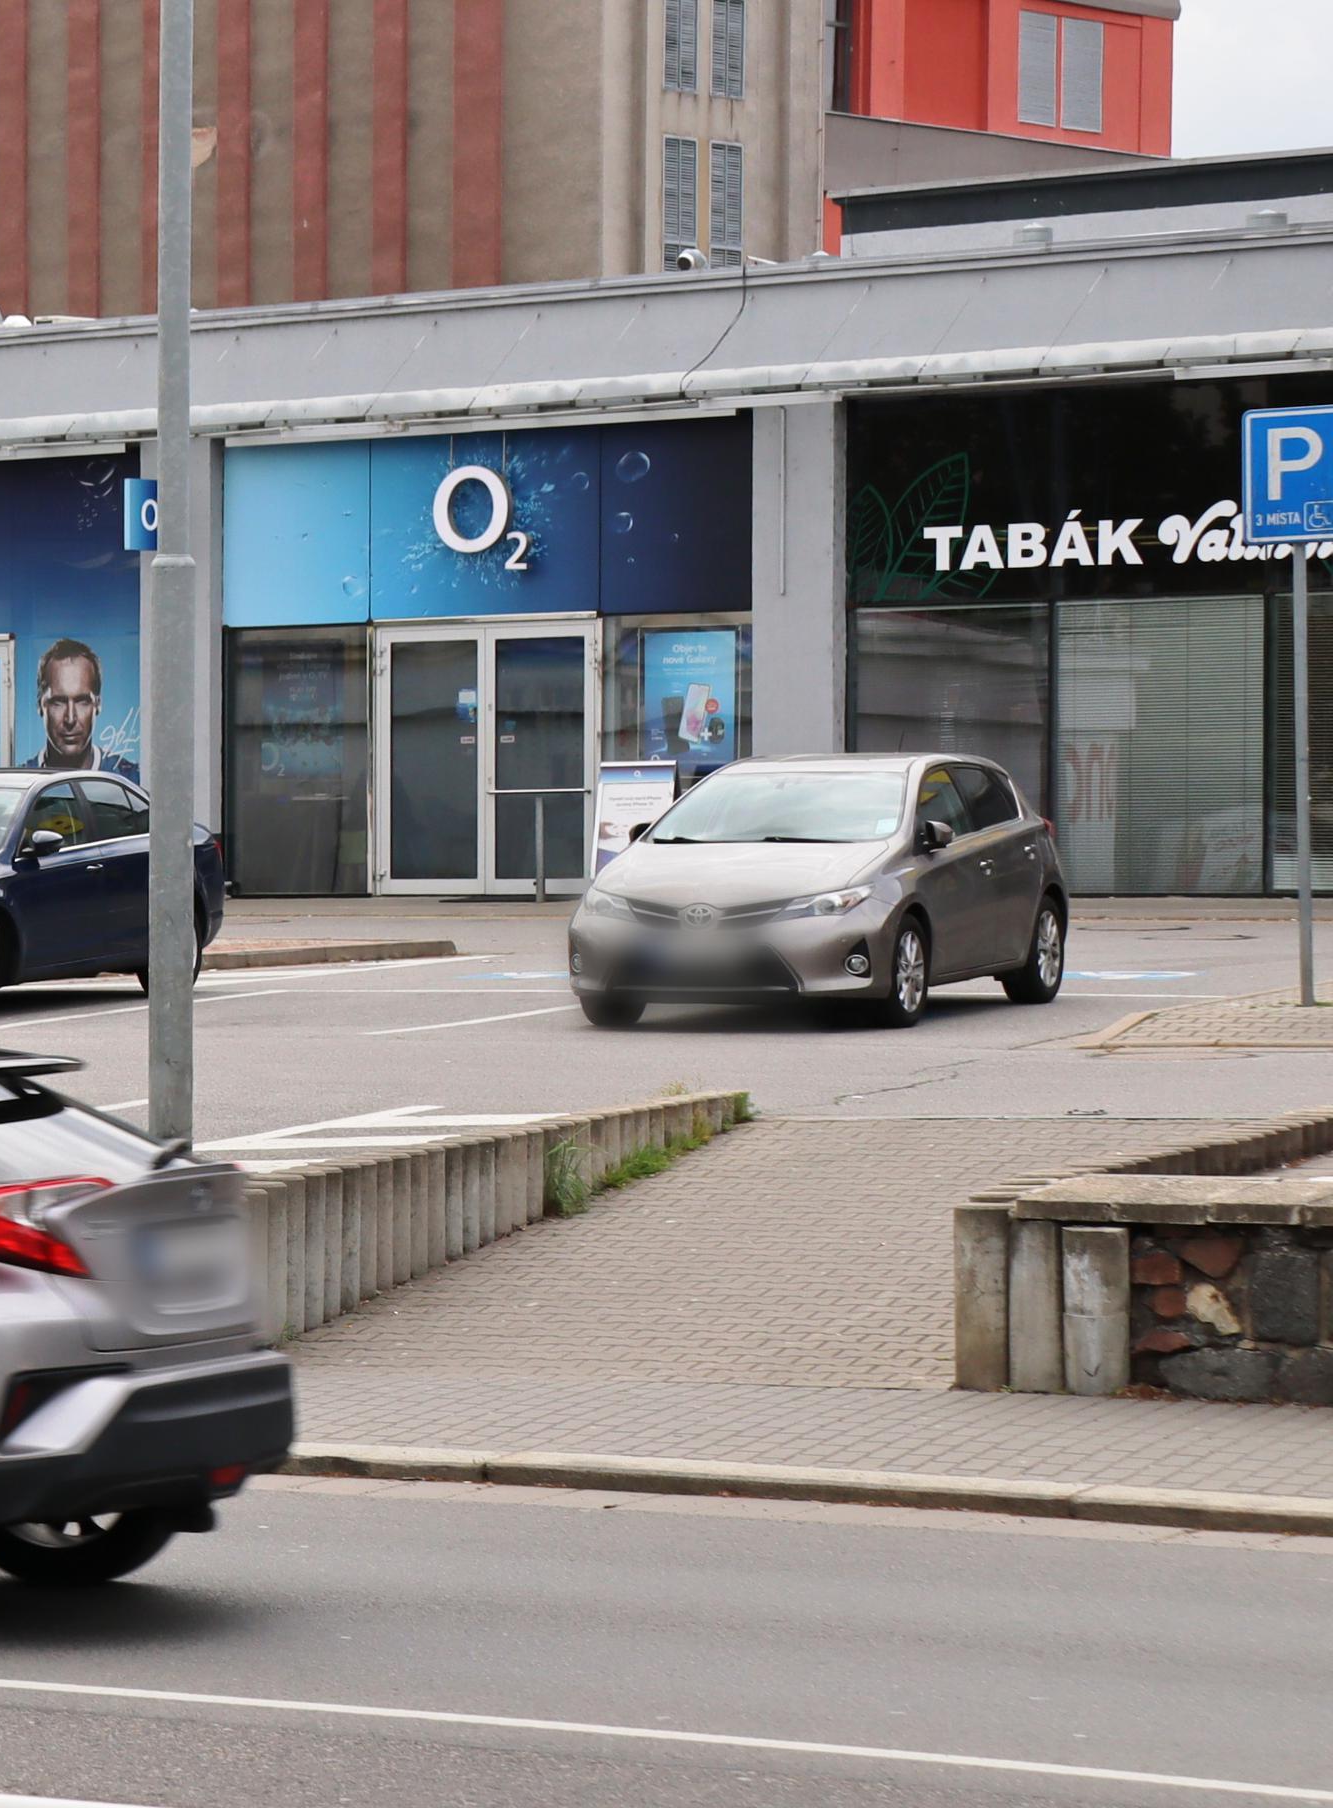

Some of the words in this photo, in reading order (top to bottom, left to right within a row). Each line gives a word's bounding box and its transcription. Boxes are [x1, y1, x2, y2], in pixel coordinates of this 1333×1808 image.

[1267, 427, 1323, 500] P
[923, 509, 1145, 571] TABÁK
[1255, 513, 1264, 527] 3
[1266, 509, 1301, 526] MÍSTA
